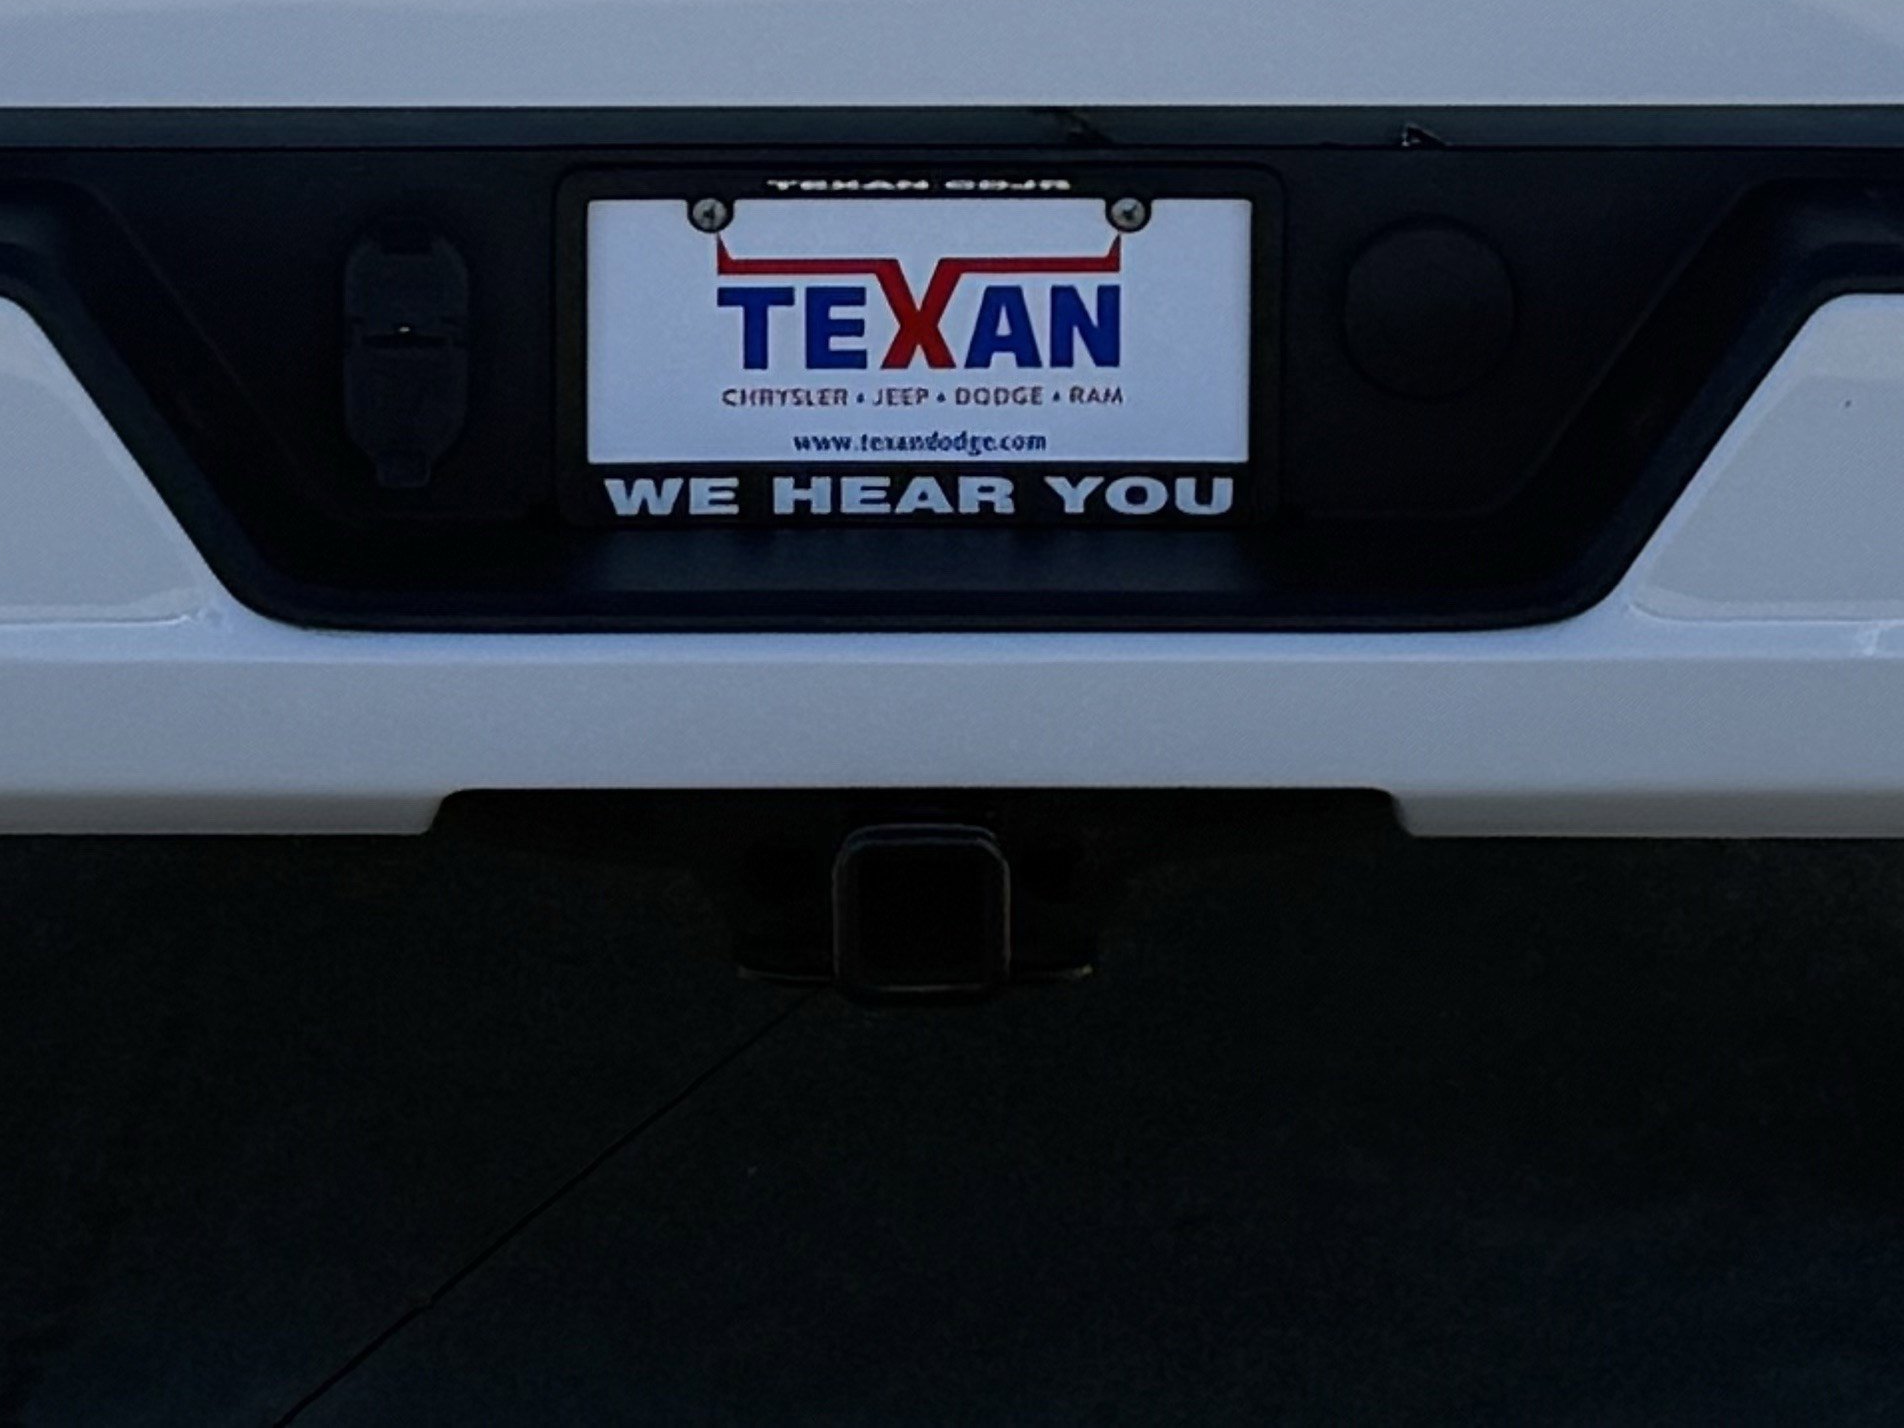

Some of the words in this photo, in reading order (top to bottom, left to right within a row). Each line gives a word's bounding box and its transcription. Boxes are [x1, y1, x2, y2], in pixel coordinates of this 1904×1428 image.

[716, 258, 1121, 370] TEXAN
[721, 387, 849, 407] CHRYSLER
[871, 387, 931, 406] JEEP
[954, 386, 1045, 405] DODGE
[1068, 385, 1125, 405] RAM
[793, 431, 1048, 456] www.texandodge.com
[603, 476, 740, 517] WE
[772, 475, 1016, 516] HEAR
[1043, 475, 1235, 515] YOU
